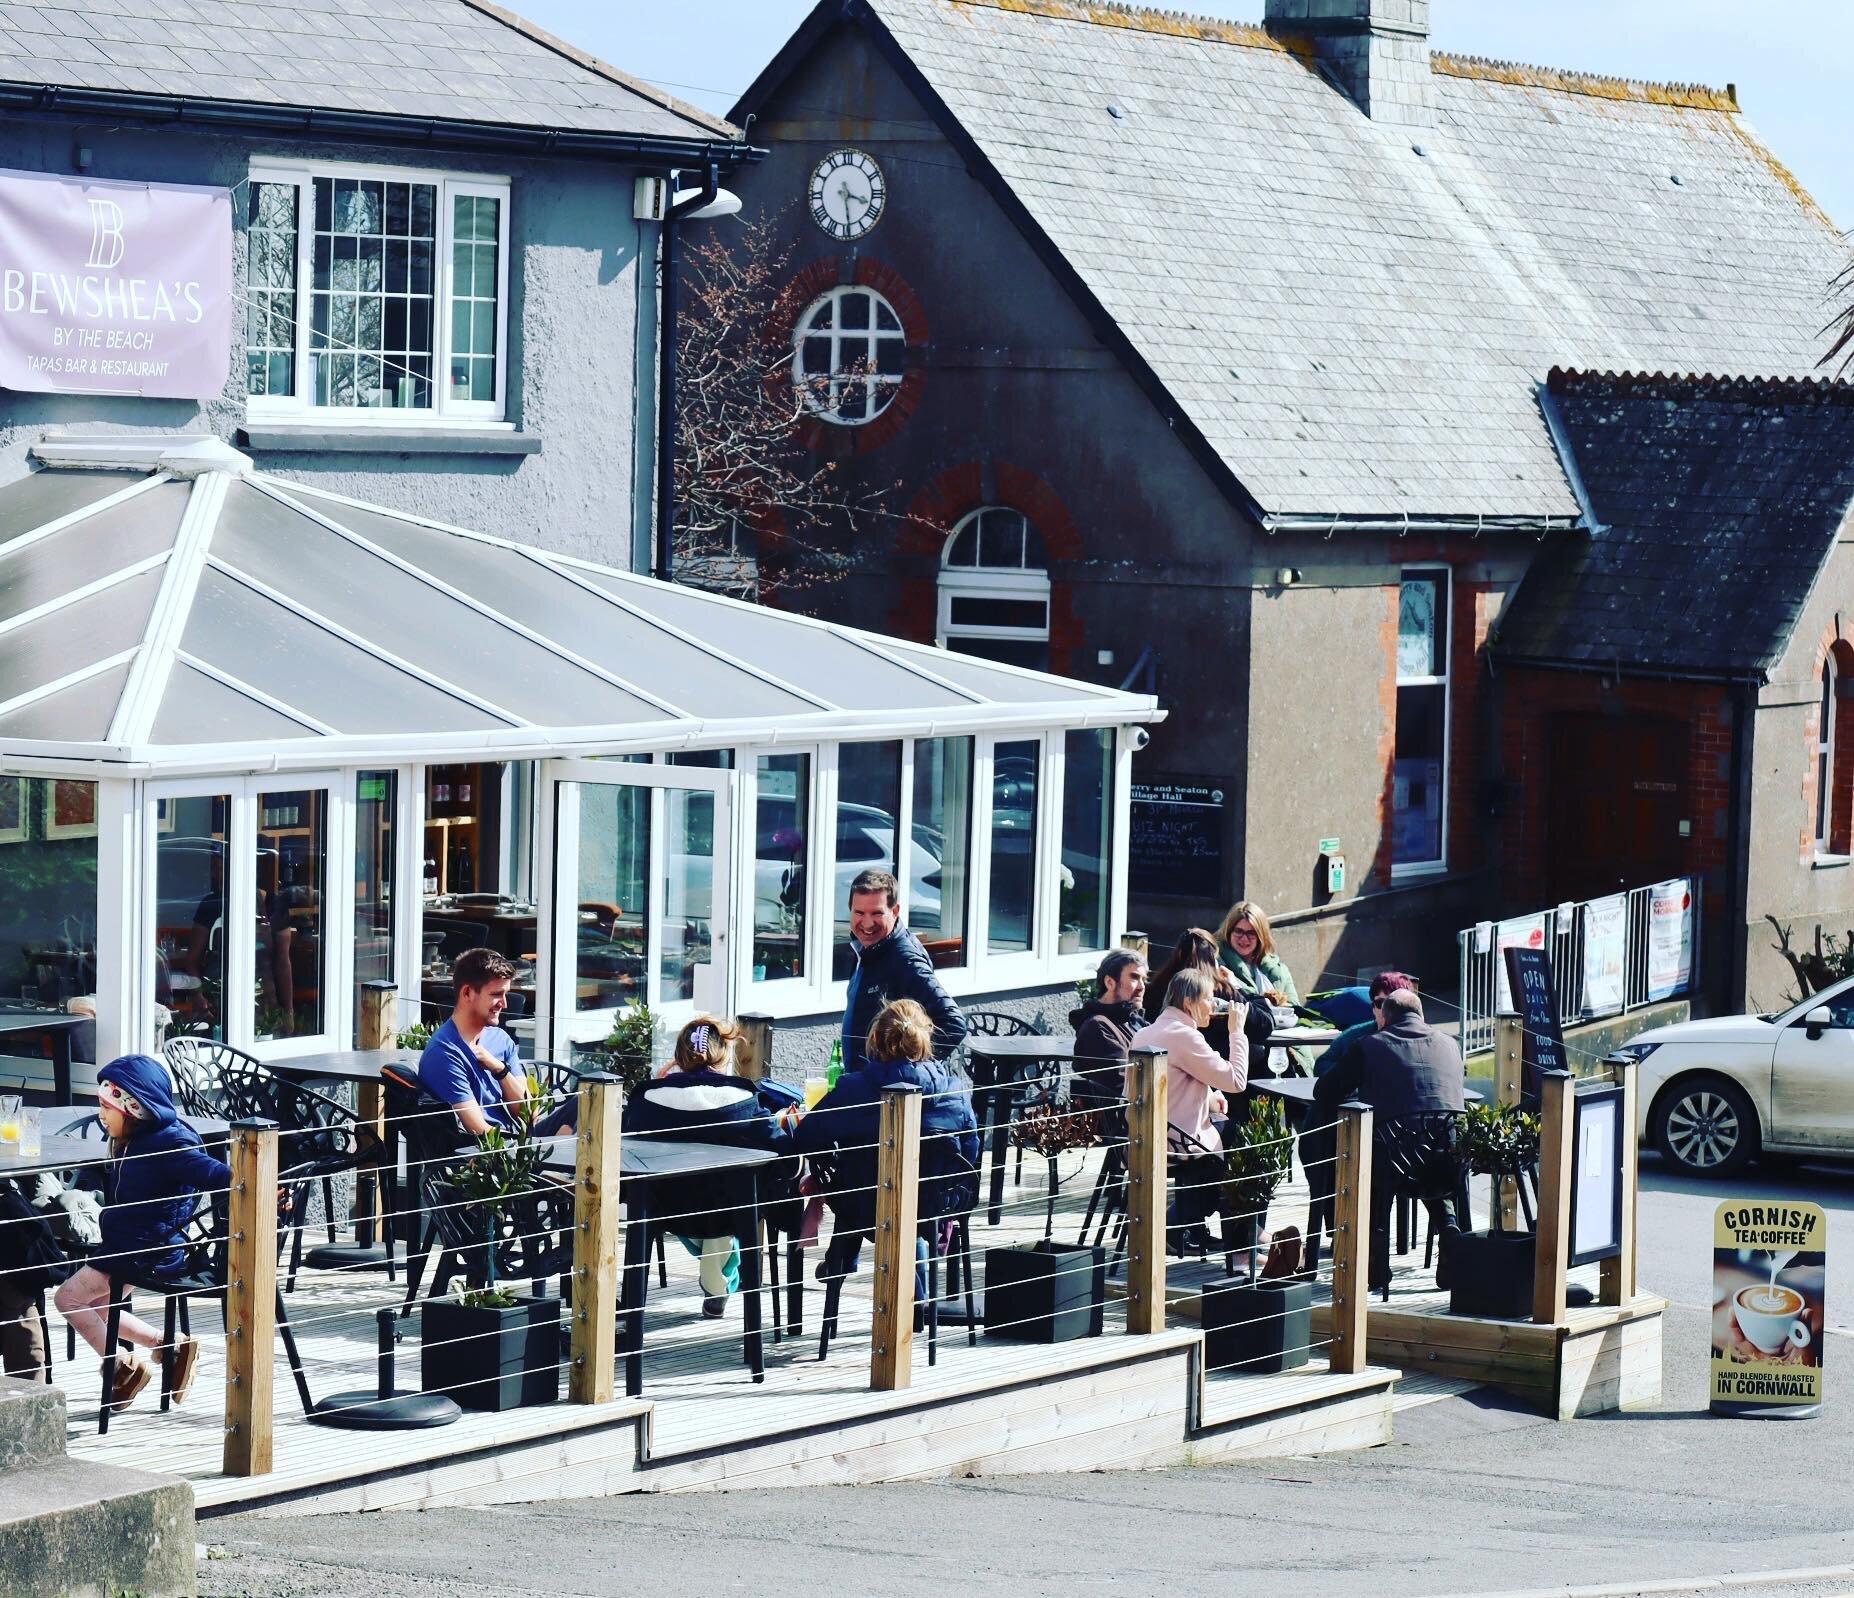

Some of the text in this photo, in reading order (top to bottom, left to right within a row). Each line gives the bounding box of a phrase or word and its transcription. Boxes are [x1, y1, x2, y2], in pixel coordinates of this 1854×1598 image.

[4, 269, 203, 323] BEWSHEA'S
[54, 327, 154, 351] BY THE BEACH
[27, 355, 169, 377] TAPAS BAR & RESTAURANT
[1131, 791, 1159, 800] illage
[1174, 786, 1208, 794] Seaton
[1132, 820, 1155, 833] UIZ
[1523, 970, 1545, 990] OPEN
[1525, 994, 1549, 1005] DAILY
[1536, 1035, 1552, 1046] FOOD
[1537, 1054, 1556, 1065] DRINK
[1724, 1208, 1816, 1232] CORNISH
[1782, 1374, 1815, 1382] ROASTED
[1717, 1380, 1815, 1397] IN CORNWALL
